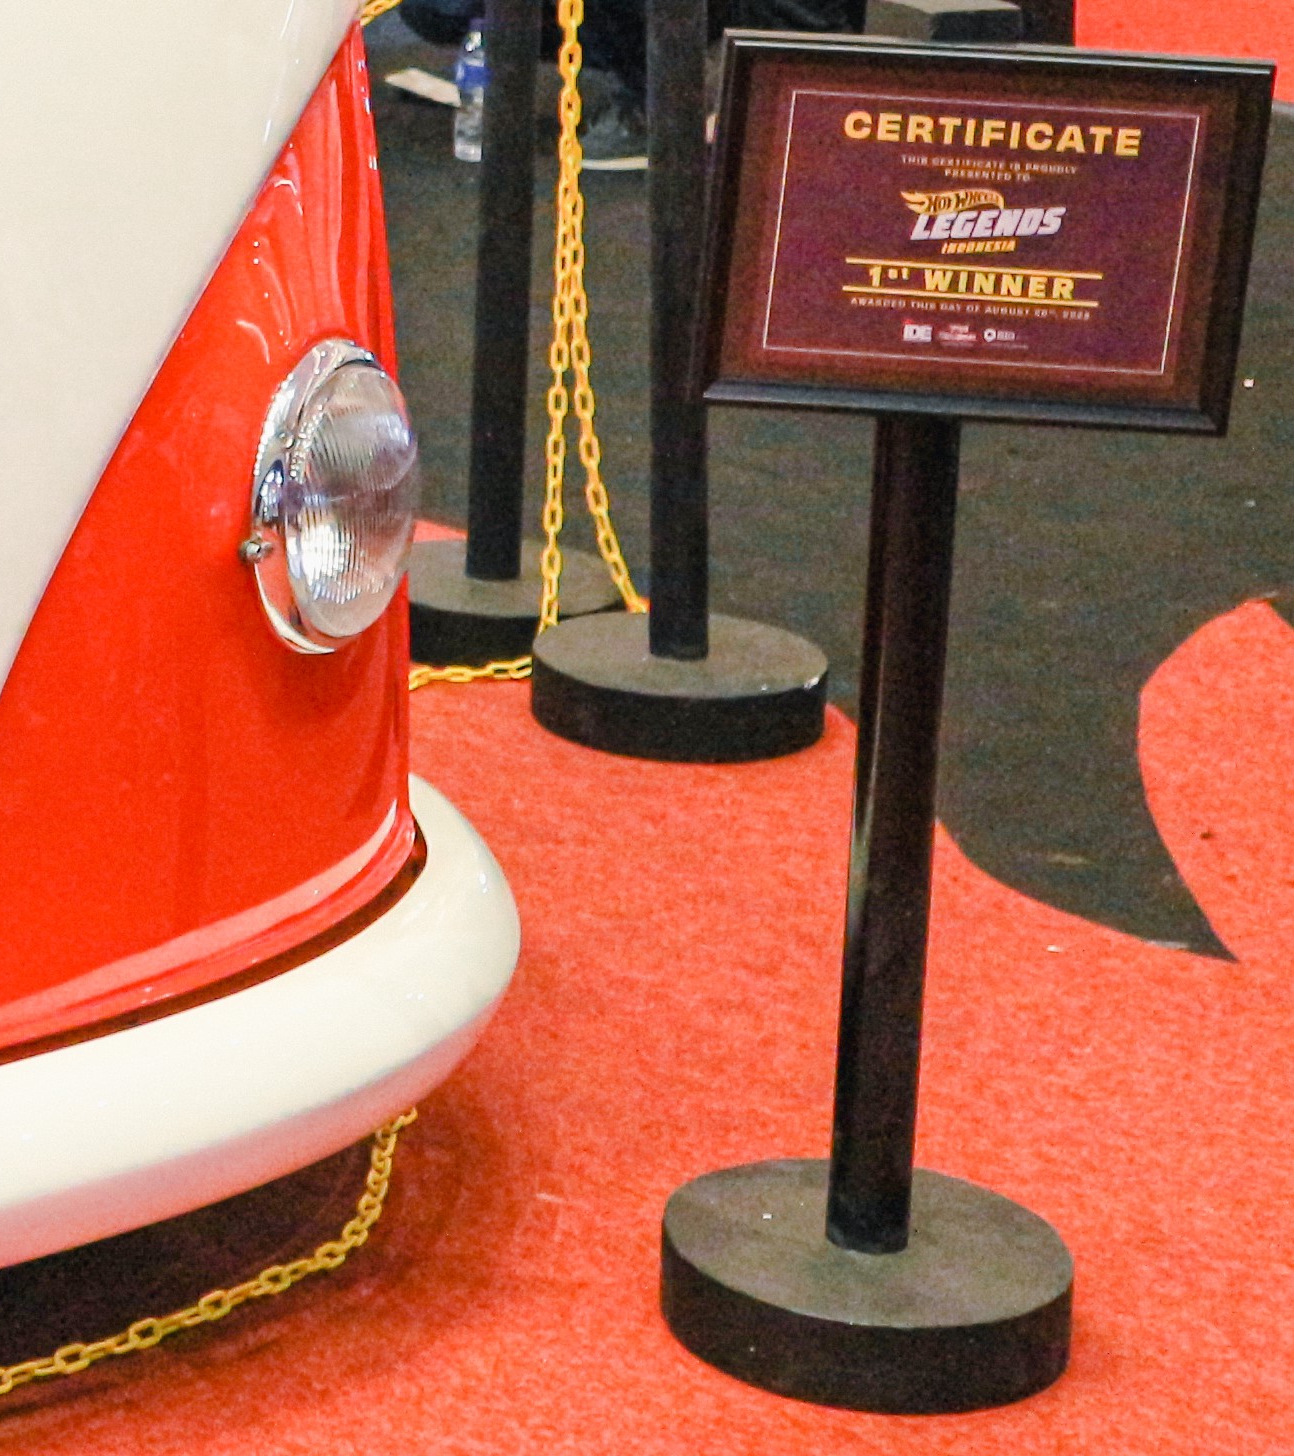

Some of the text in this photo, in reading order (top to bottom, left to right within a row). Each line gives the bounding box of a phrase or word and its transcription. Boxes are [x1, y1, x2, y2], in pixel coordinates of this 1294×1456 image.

[843, 110, 1143, 157] CERTIFICATE
[931, 156, 1005, 170] CERTIFICATE
[944, 168, 1012, 182] PRESENTED
[910, 206, 1067, 241] LEGENDS
[941, 238, 1016, 255] INDONESIA
[924, 268, 1076, 301] WINNER
